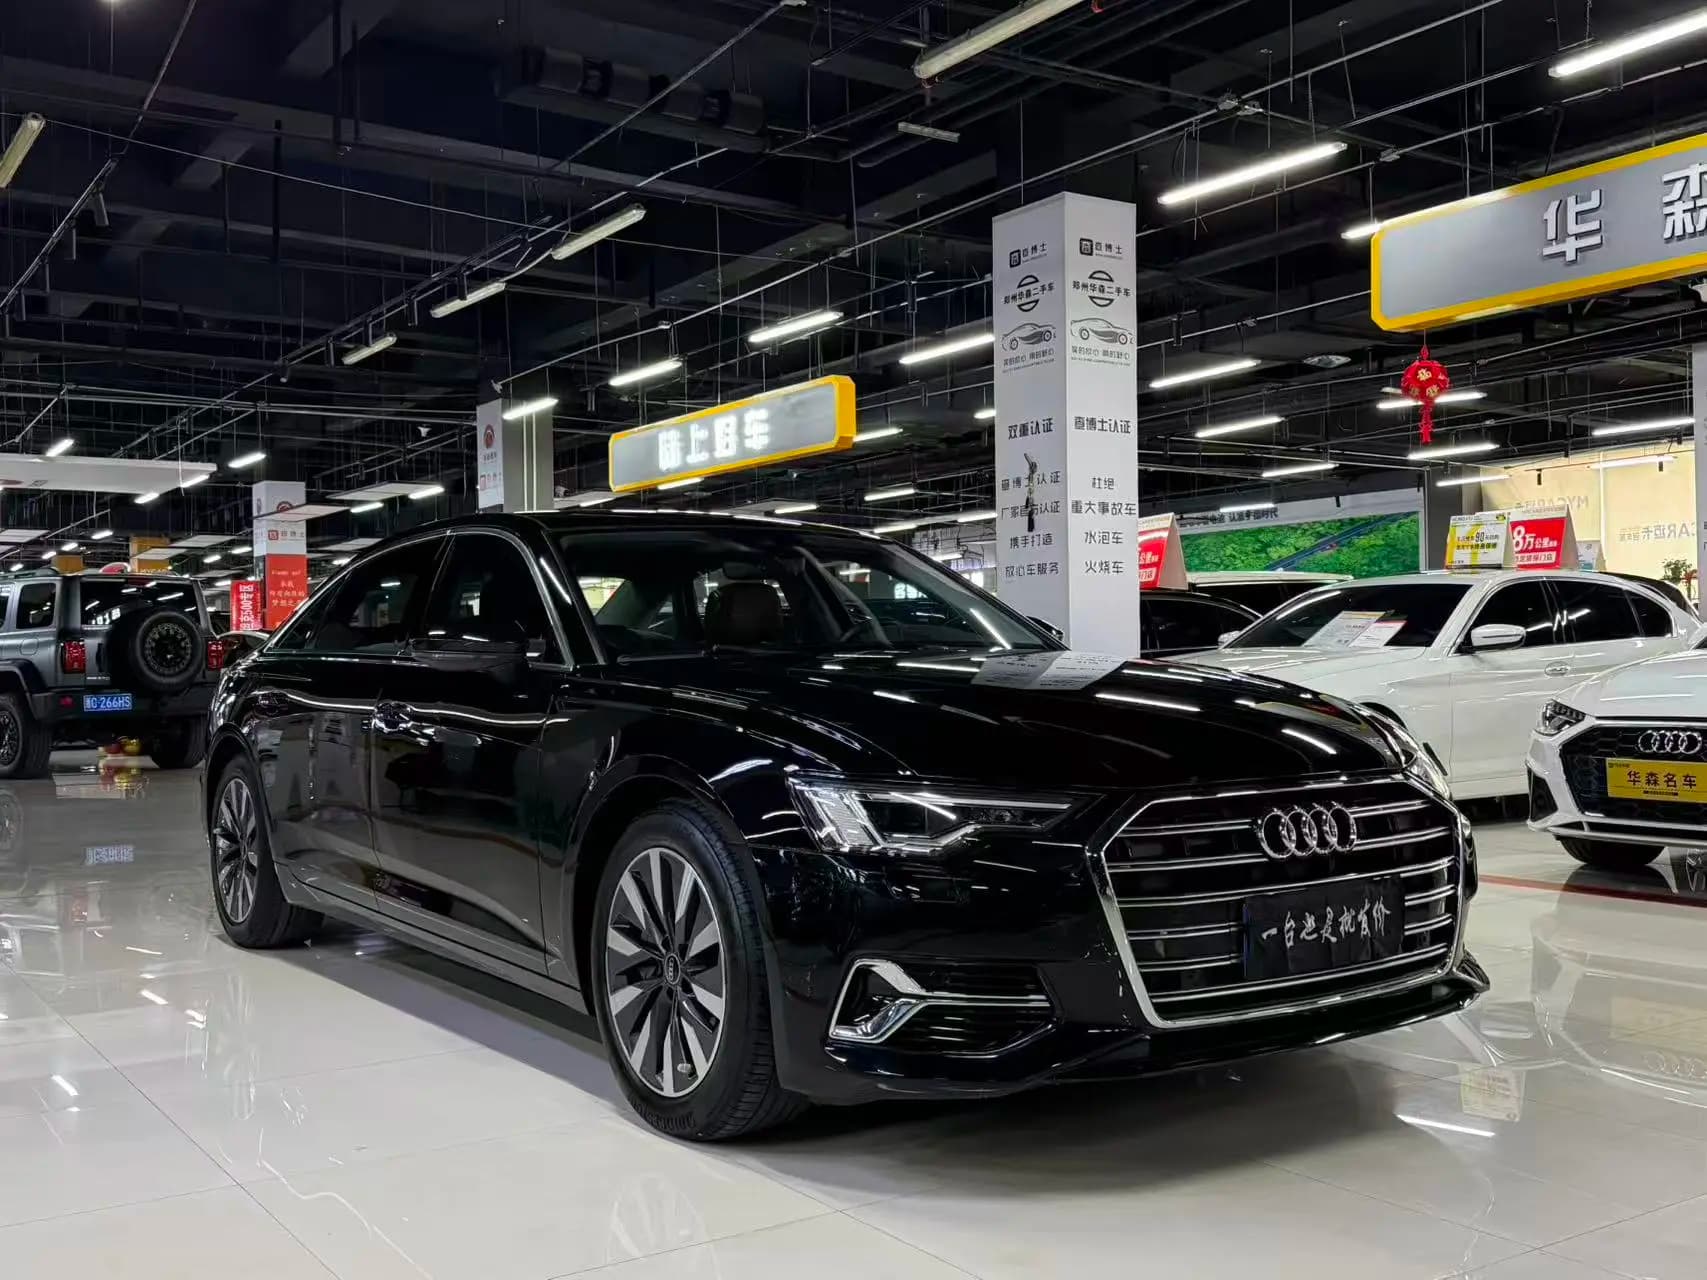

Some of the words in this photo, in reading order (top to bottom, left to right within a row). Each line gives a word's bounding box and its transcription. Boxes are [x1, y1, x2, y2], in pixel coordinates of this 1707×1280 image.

[1008, 418, 1053, 440] 双重认证
[1092, 477, 1114, 490] 杜绝
[1071, 500, 1136, 516] 重大事故车
[1010, 533, 1053, 549] 携手打造
[1085, 531, 1124, 545] 水泡车
[1005, 562, 1059, 578] 放心车服务
[1085, 560, 1125, 574] 火烧车
[1627, 770, 1696, 789] 华森名车
[1262, 896, 1391, 949] 一台也是批发价
